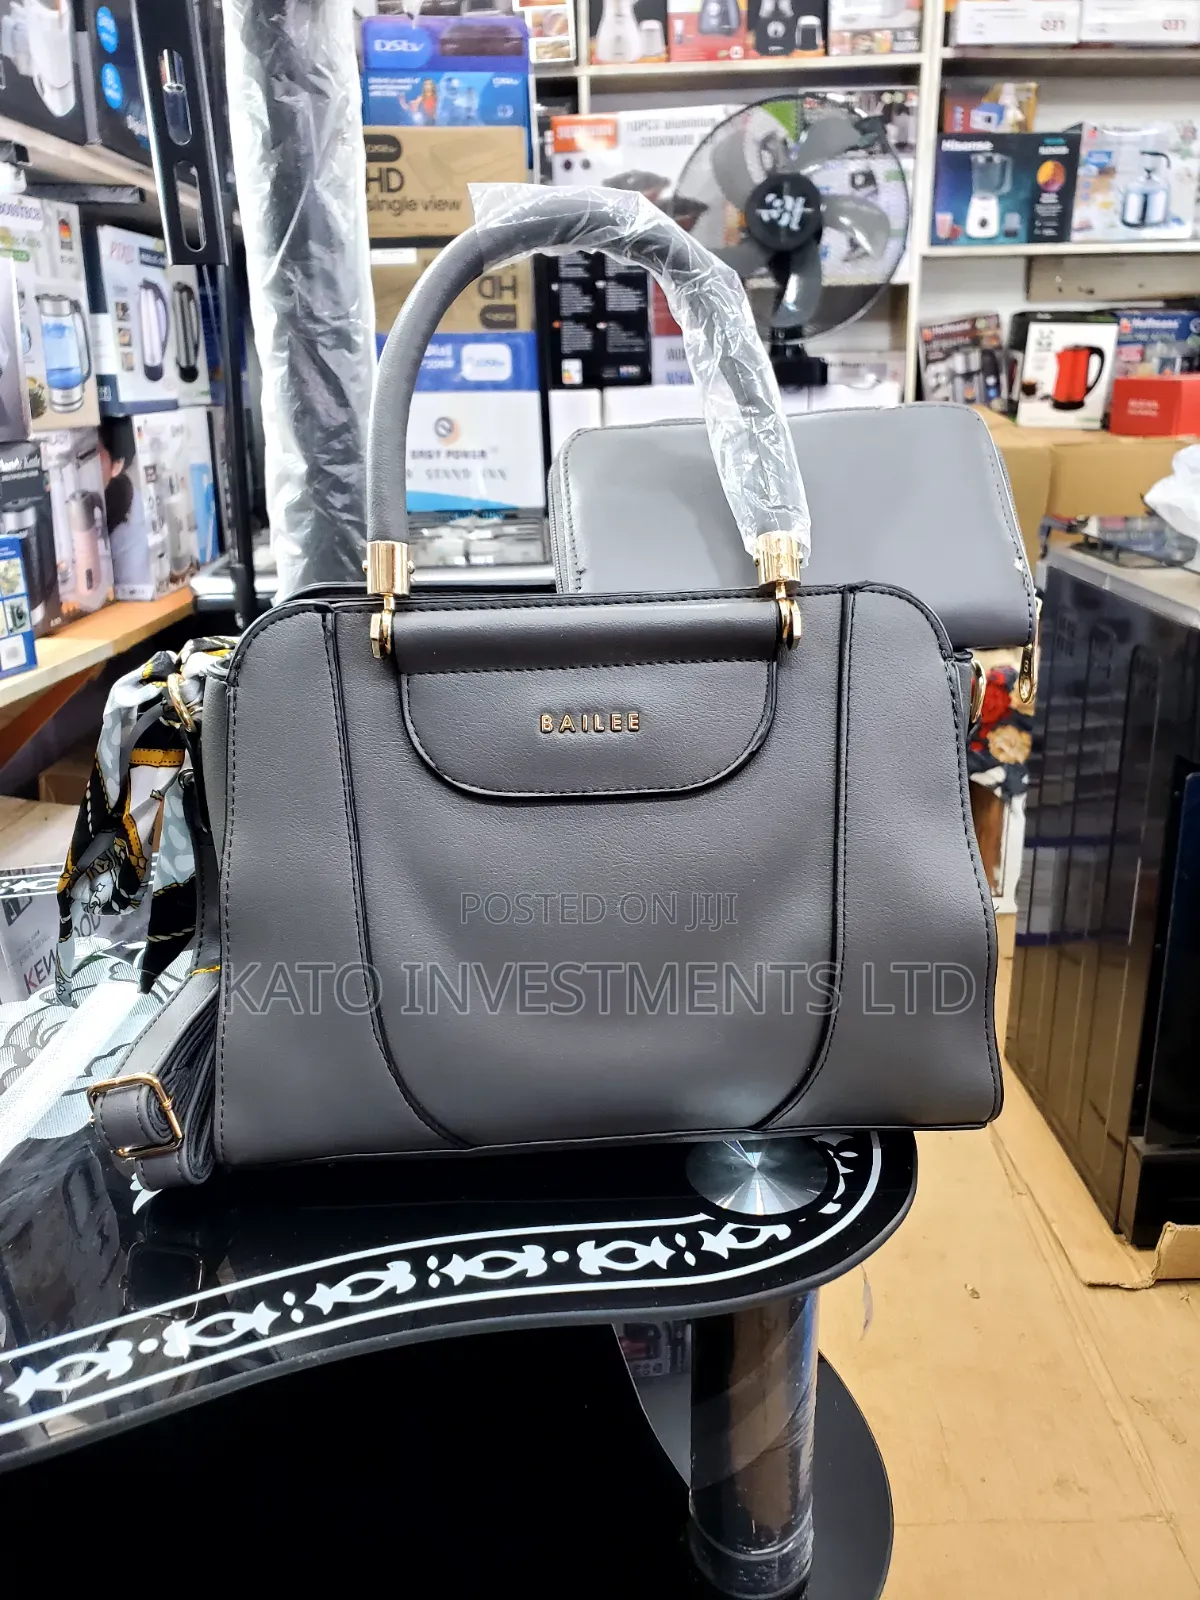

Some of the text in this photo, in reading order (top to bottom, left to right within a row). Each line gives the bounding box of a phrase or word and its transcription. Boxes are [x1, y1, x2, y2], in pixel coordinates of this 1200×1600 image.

[366, 167, 405, 194] HD
[367, 195, 463, 217] single view
[540, 711, 640, 733] BAILEE
